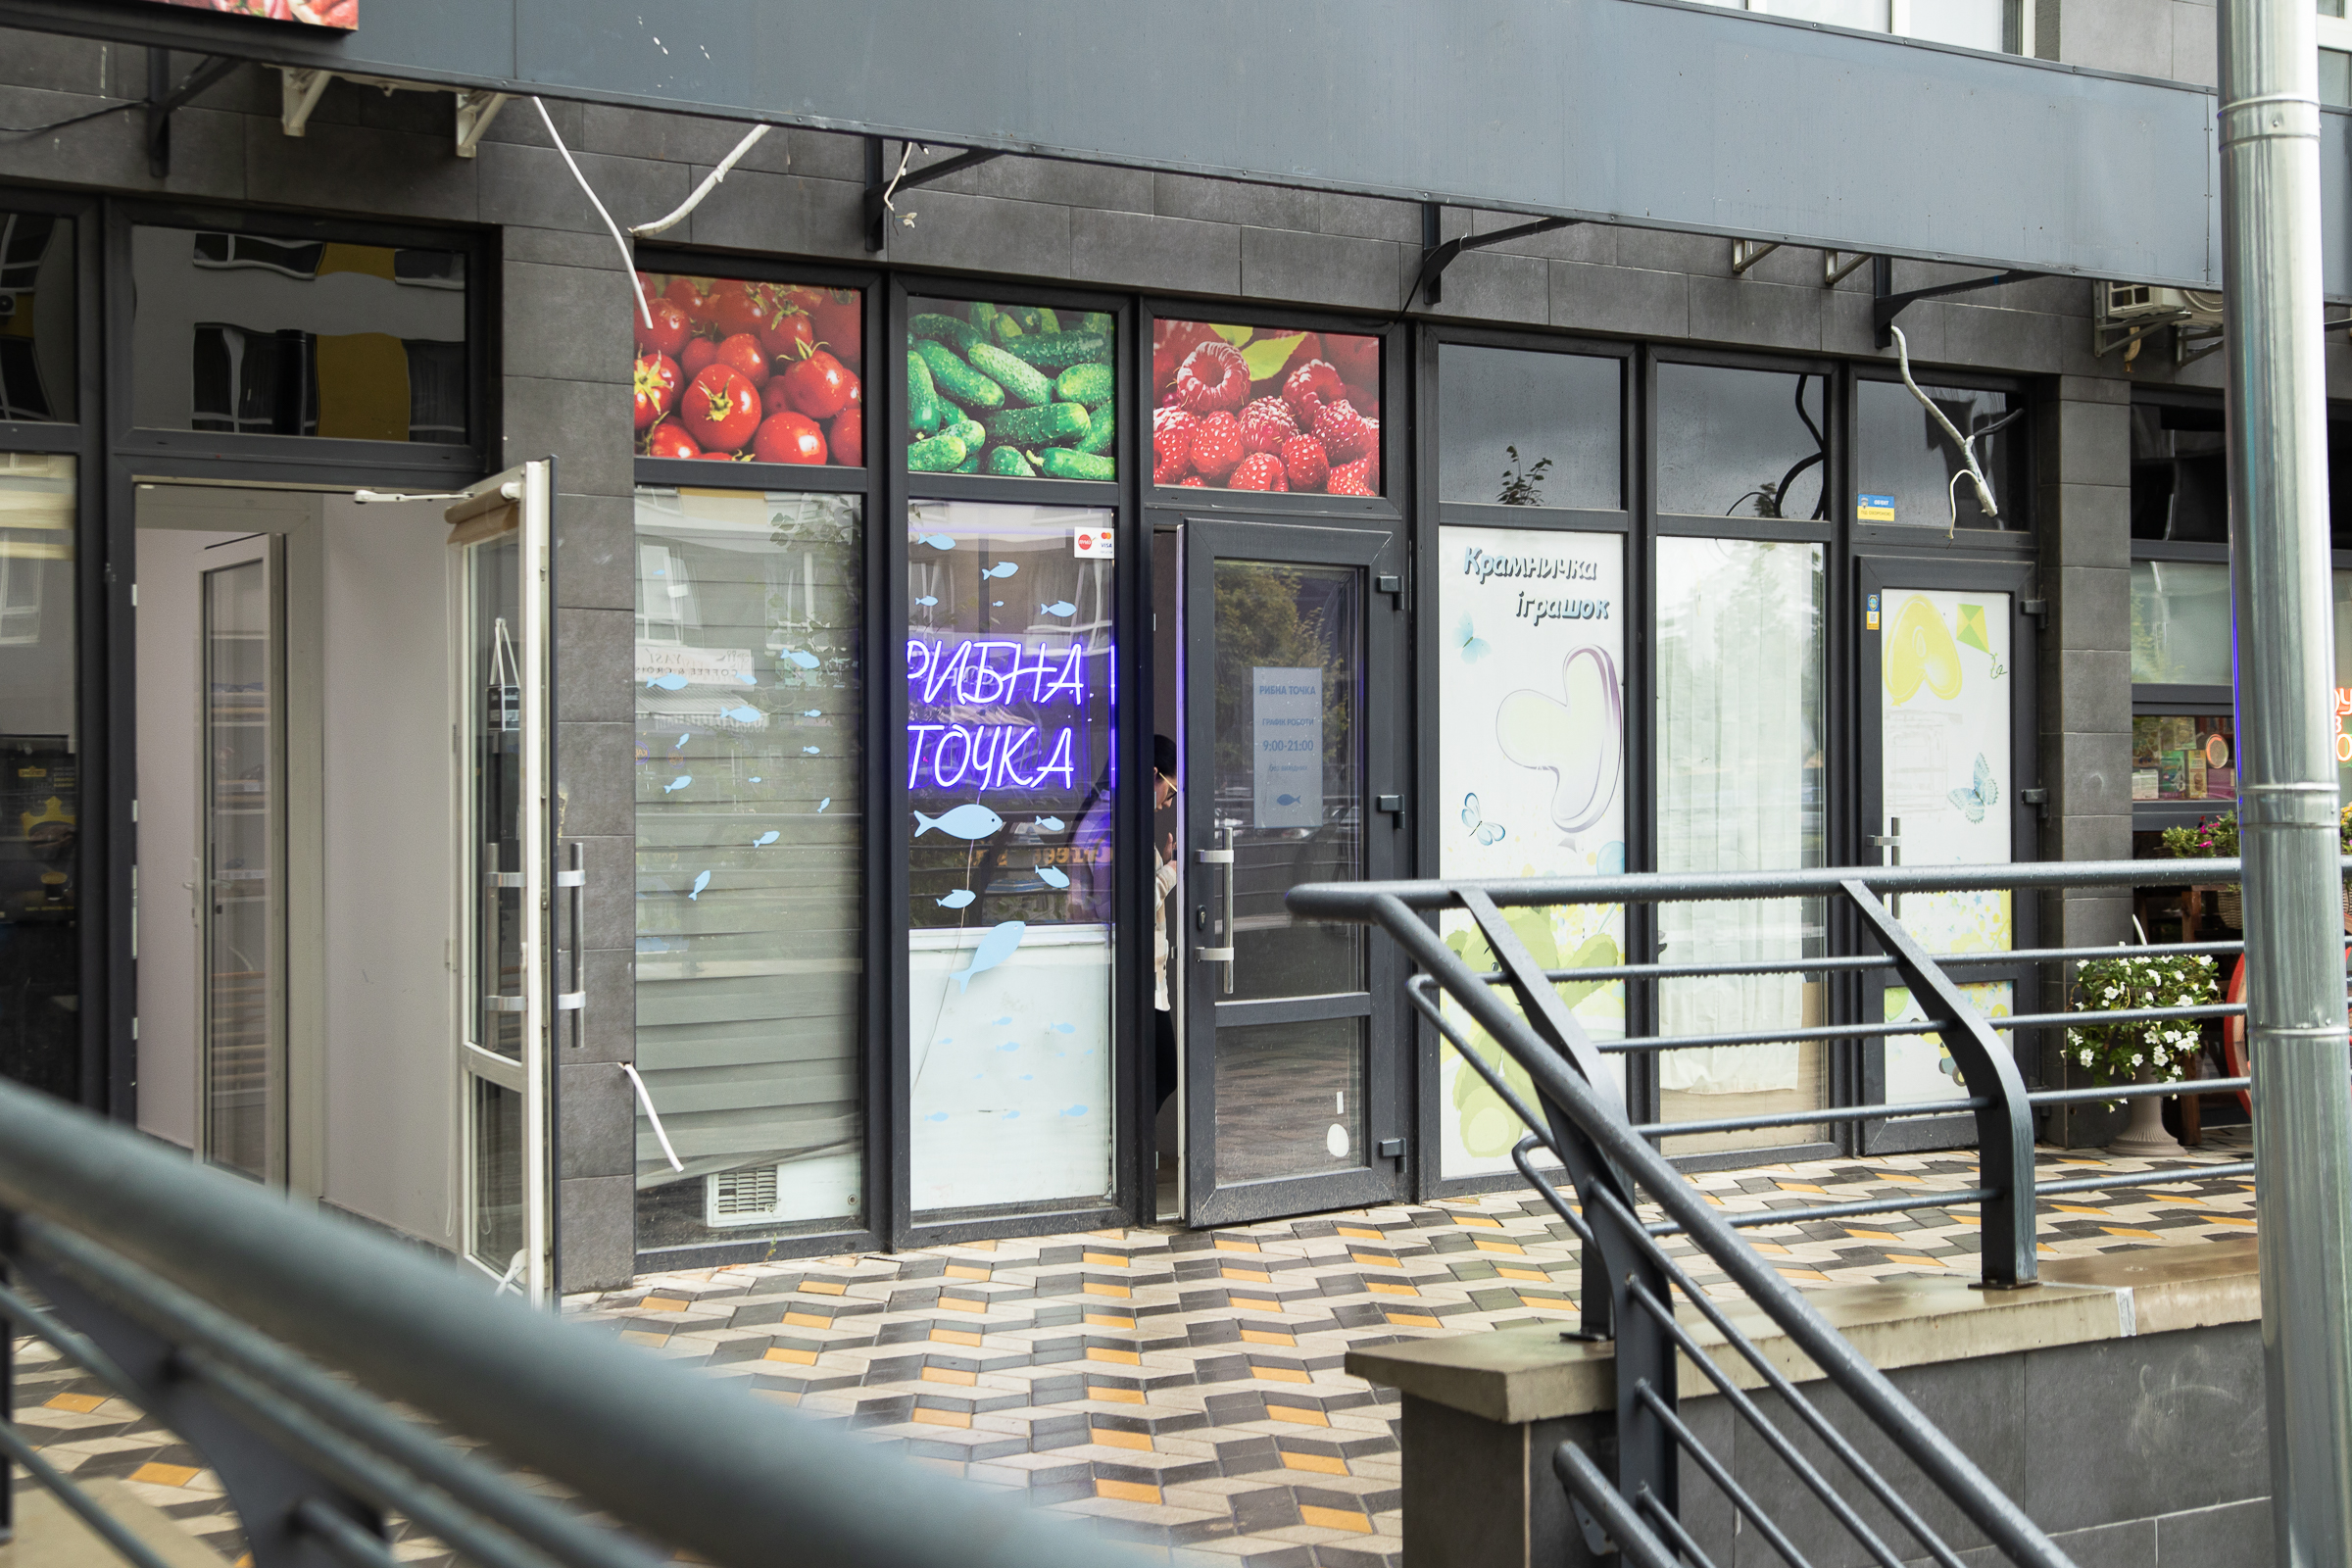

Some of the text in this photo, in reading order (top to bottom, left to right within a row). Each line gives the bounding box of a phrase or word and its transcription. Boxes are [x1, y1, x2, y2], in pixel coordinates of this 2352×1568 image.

[1464, 546, 1597, 585] Крамничка
[1516, 591, 1610, 627] іграшок
[906, 640, 1084, 706] РИБНА
[1259, 685, 1316, 695] РИБНА ТОЧКА
[1287, 718, 1314, 727] РОБОТИ
[906, 723, 1075, 791] ТОЧКА
[1262, 740, 1314, 752] 9:00-21:00
